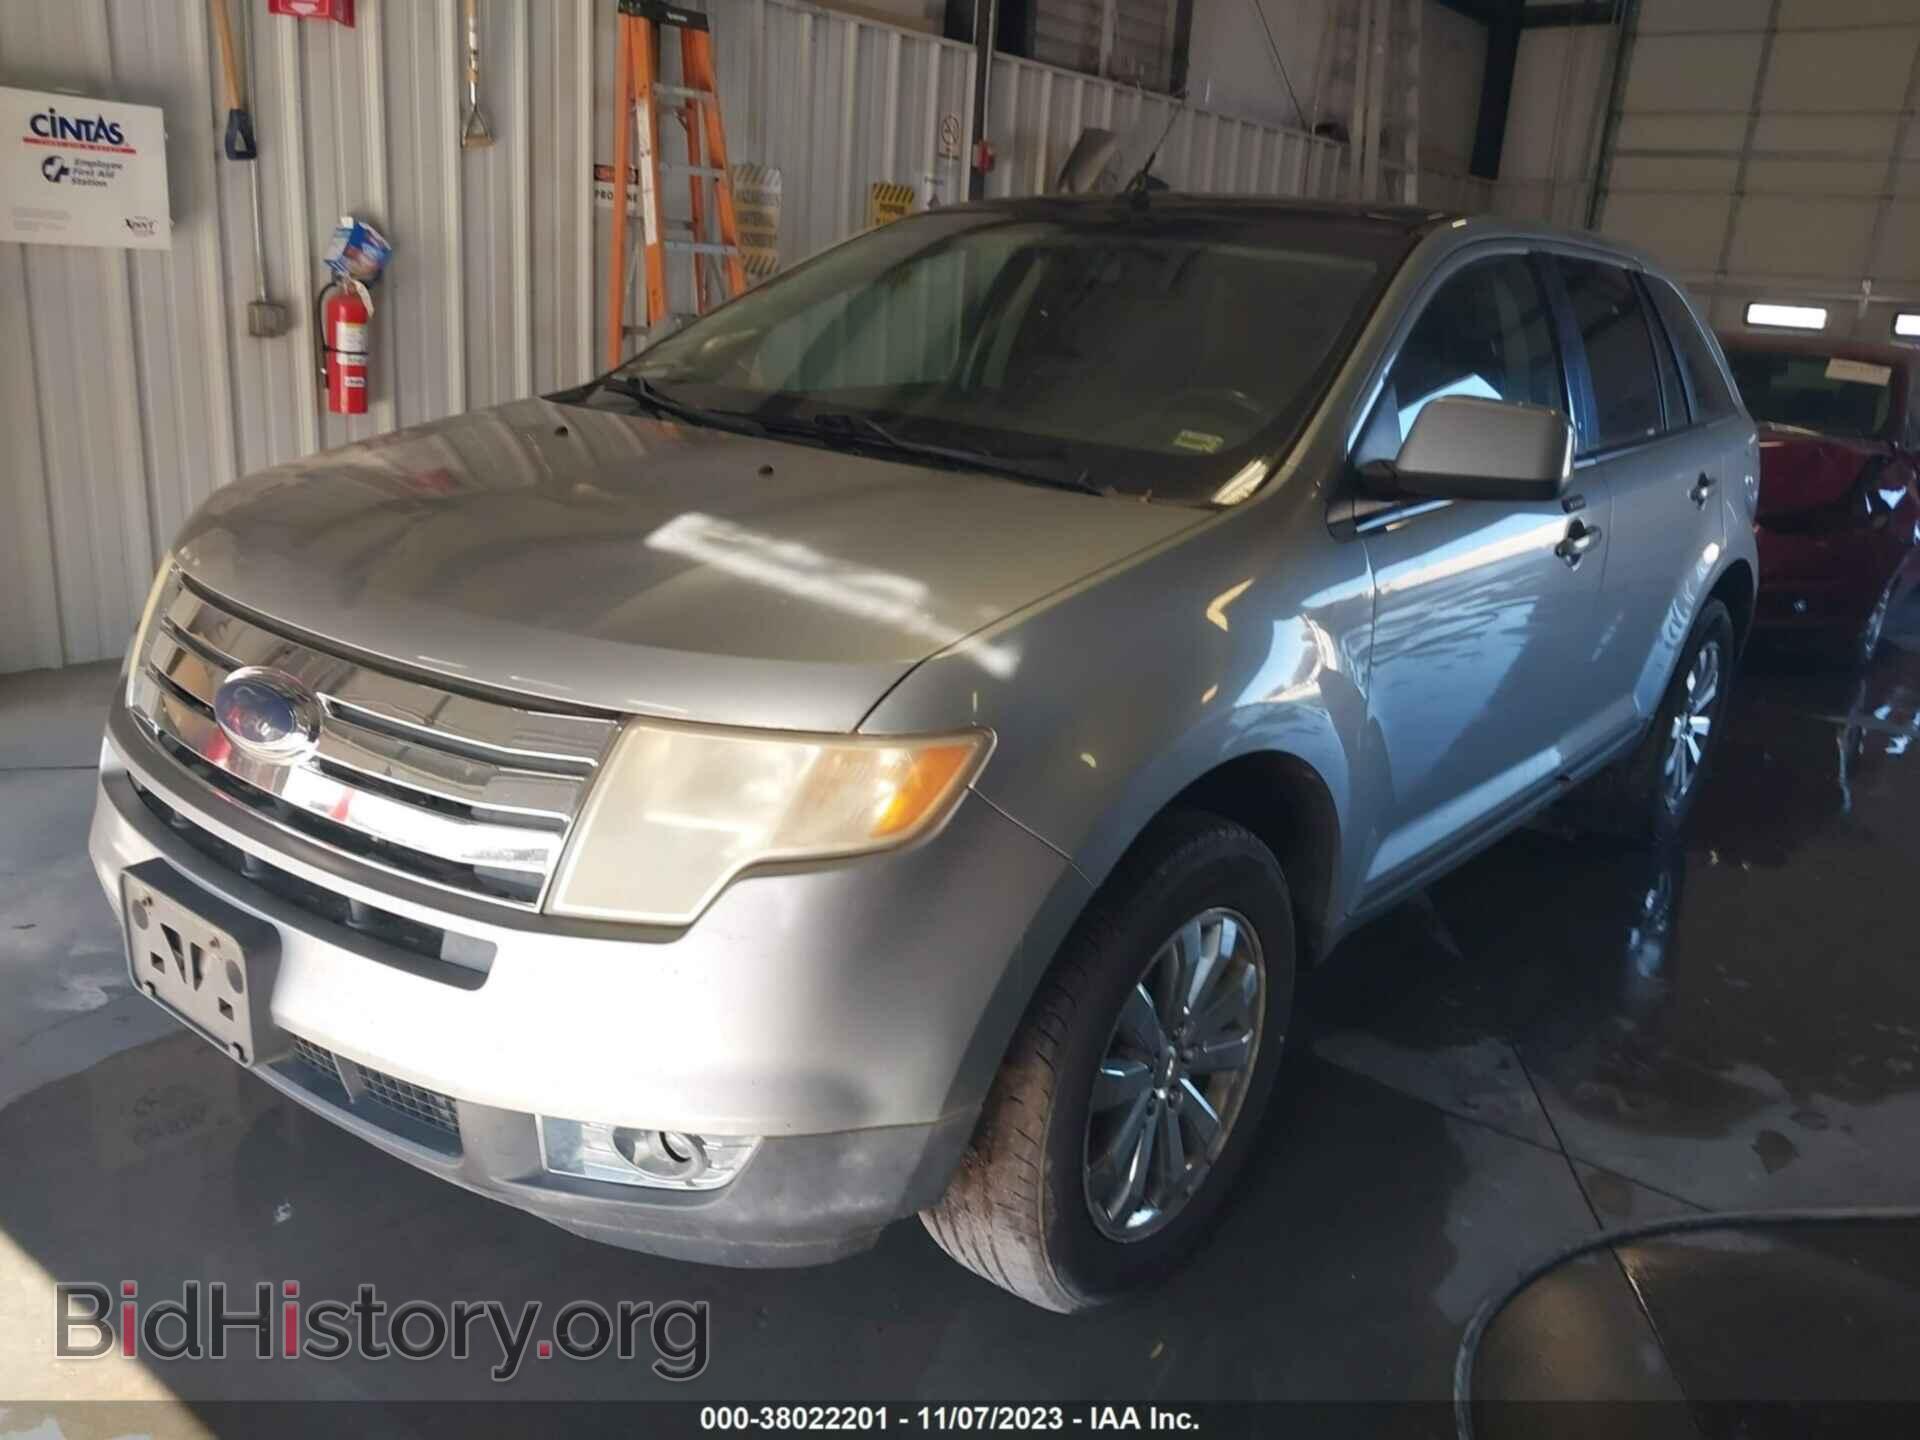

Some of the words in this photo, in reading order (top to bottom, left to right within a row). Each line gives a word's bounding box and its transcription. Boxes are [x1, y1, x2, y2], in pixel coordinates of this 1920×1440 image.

[74, 158, 123, 170] Employee
[73, 167, 94, 176] First
[98, 169, 114, 179] Aid
[72, 177, 107, 187] Station
